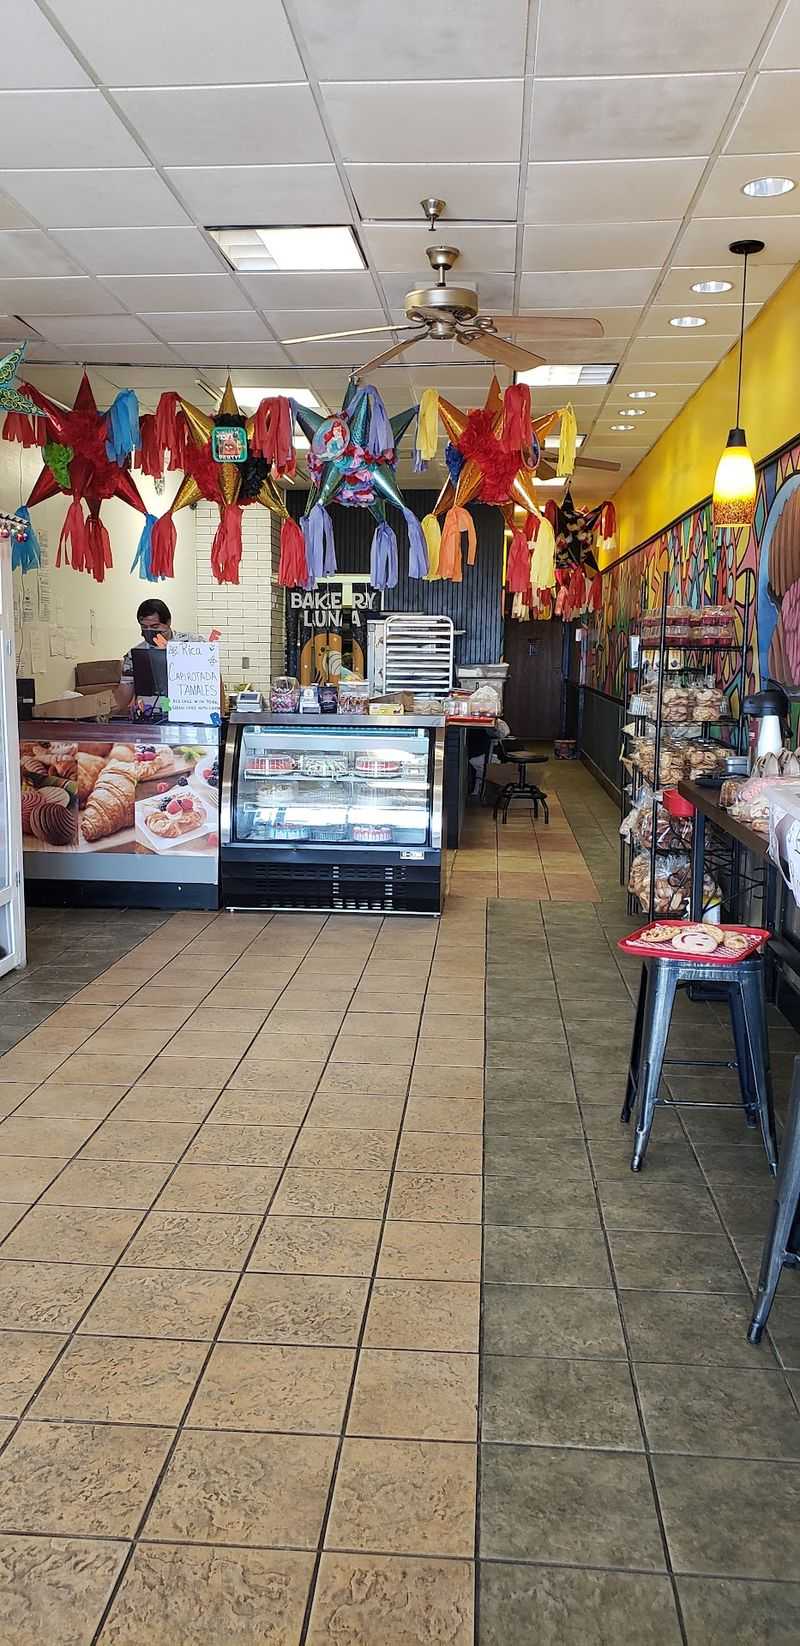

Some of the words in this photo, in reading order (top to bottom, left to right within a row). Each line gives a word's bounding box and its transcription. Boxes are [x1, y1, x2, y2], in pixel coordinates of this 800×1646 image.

[291, 592, 376, 609] BAKERY
[304, 610, 361, 627] LUNA
[178, 683, 218, 697] TAMALES
